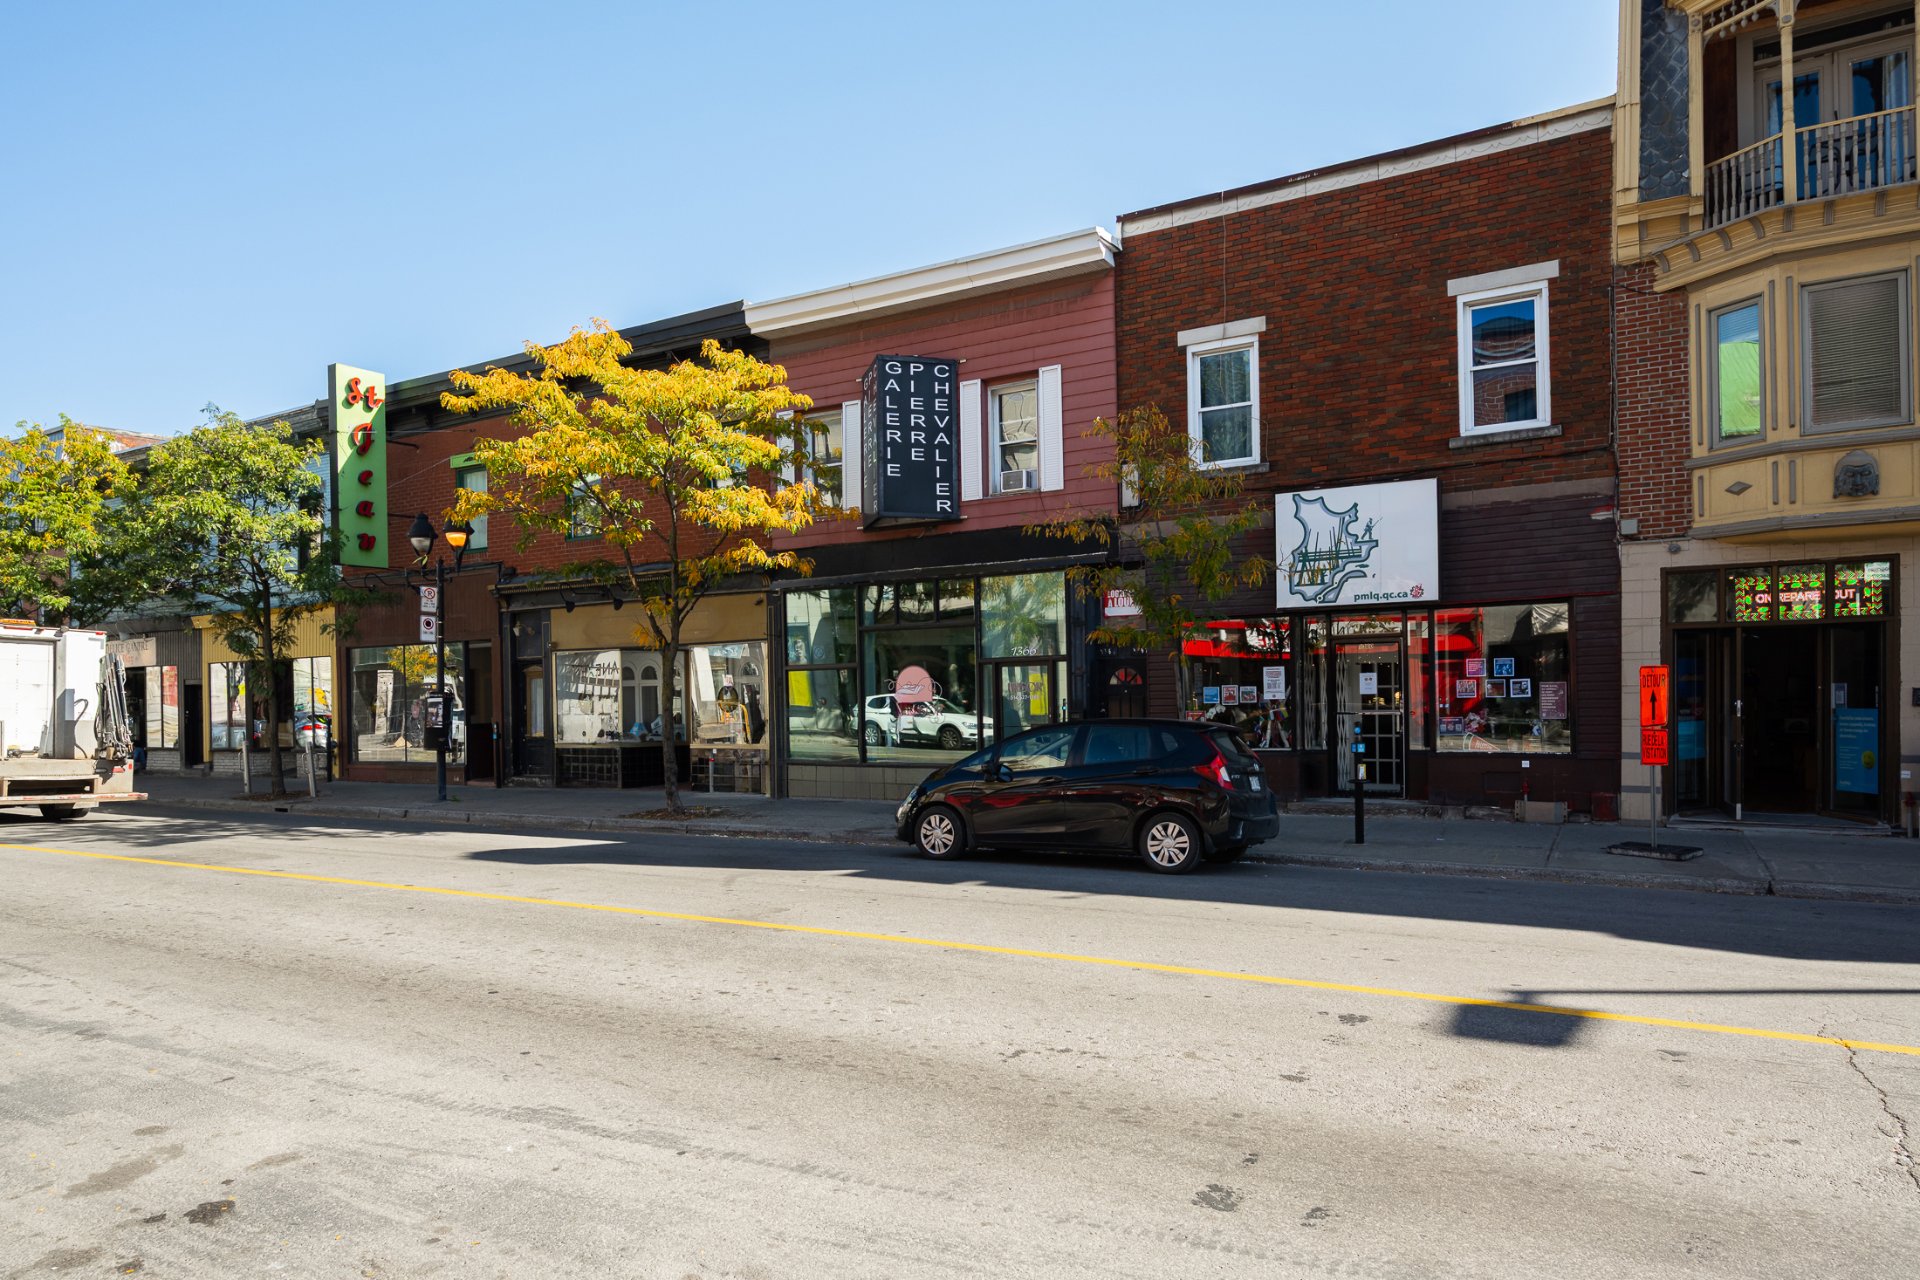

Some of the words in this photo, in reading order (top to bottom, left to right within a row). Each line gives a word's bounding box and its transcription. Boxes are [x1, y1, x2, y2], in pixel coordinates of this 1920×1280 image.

[884, 361, 902, 477] GALERIE
[910, 363, 926, 461] PIERRE
[934, 365, 952, 512] CHEVALIER
[1354, 592, 1408, 602] pmlq.qc.ca
